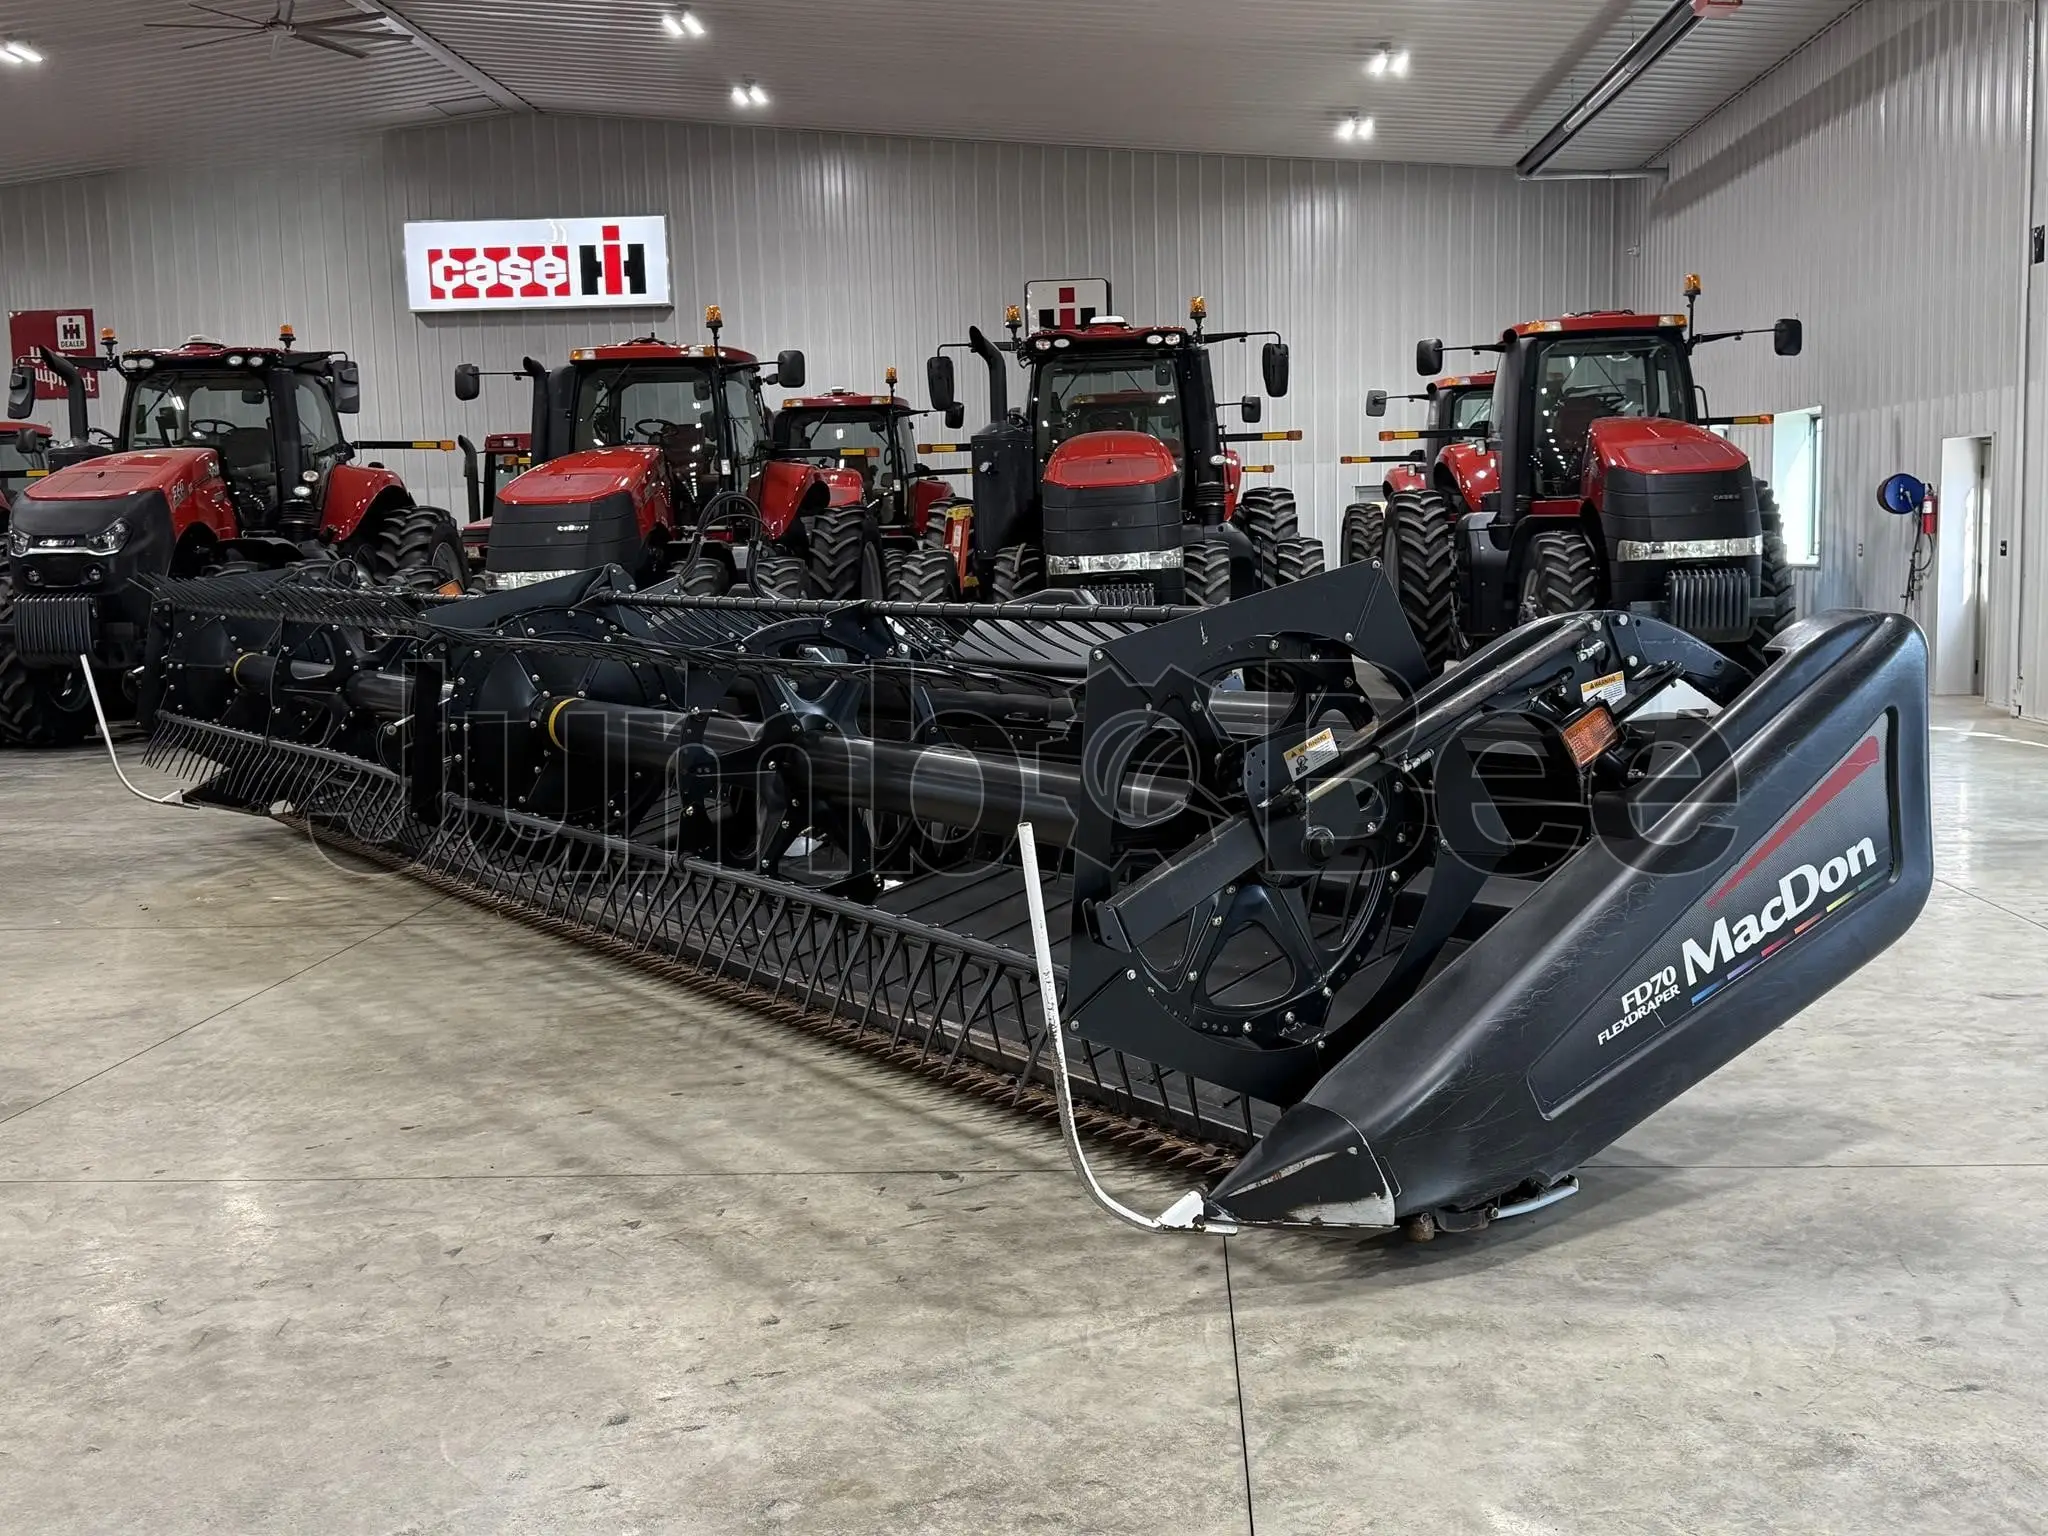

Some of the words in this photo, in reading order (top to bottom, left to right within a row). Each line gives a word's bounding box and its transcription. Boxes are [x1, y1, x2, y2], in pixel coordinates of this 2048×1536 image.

[60, 340, 85, 348] DEALER
[1297, 734, 1327, 753] WARNING
[1681, 836, 1877, 986] MacDon
[1621, 965, 1677, 1014] FD70
[1597, 984, 1681, 1045] FLEXDRAPER
